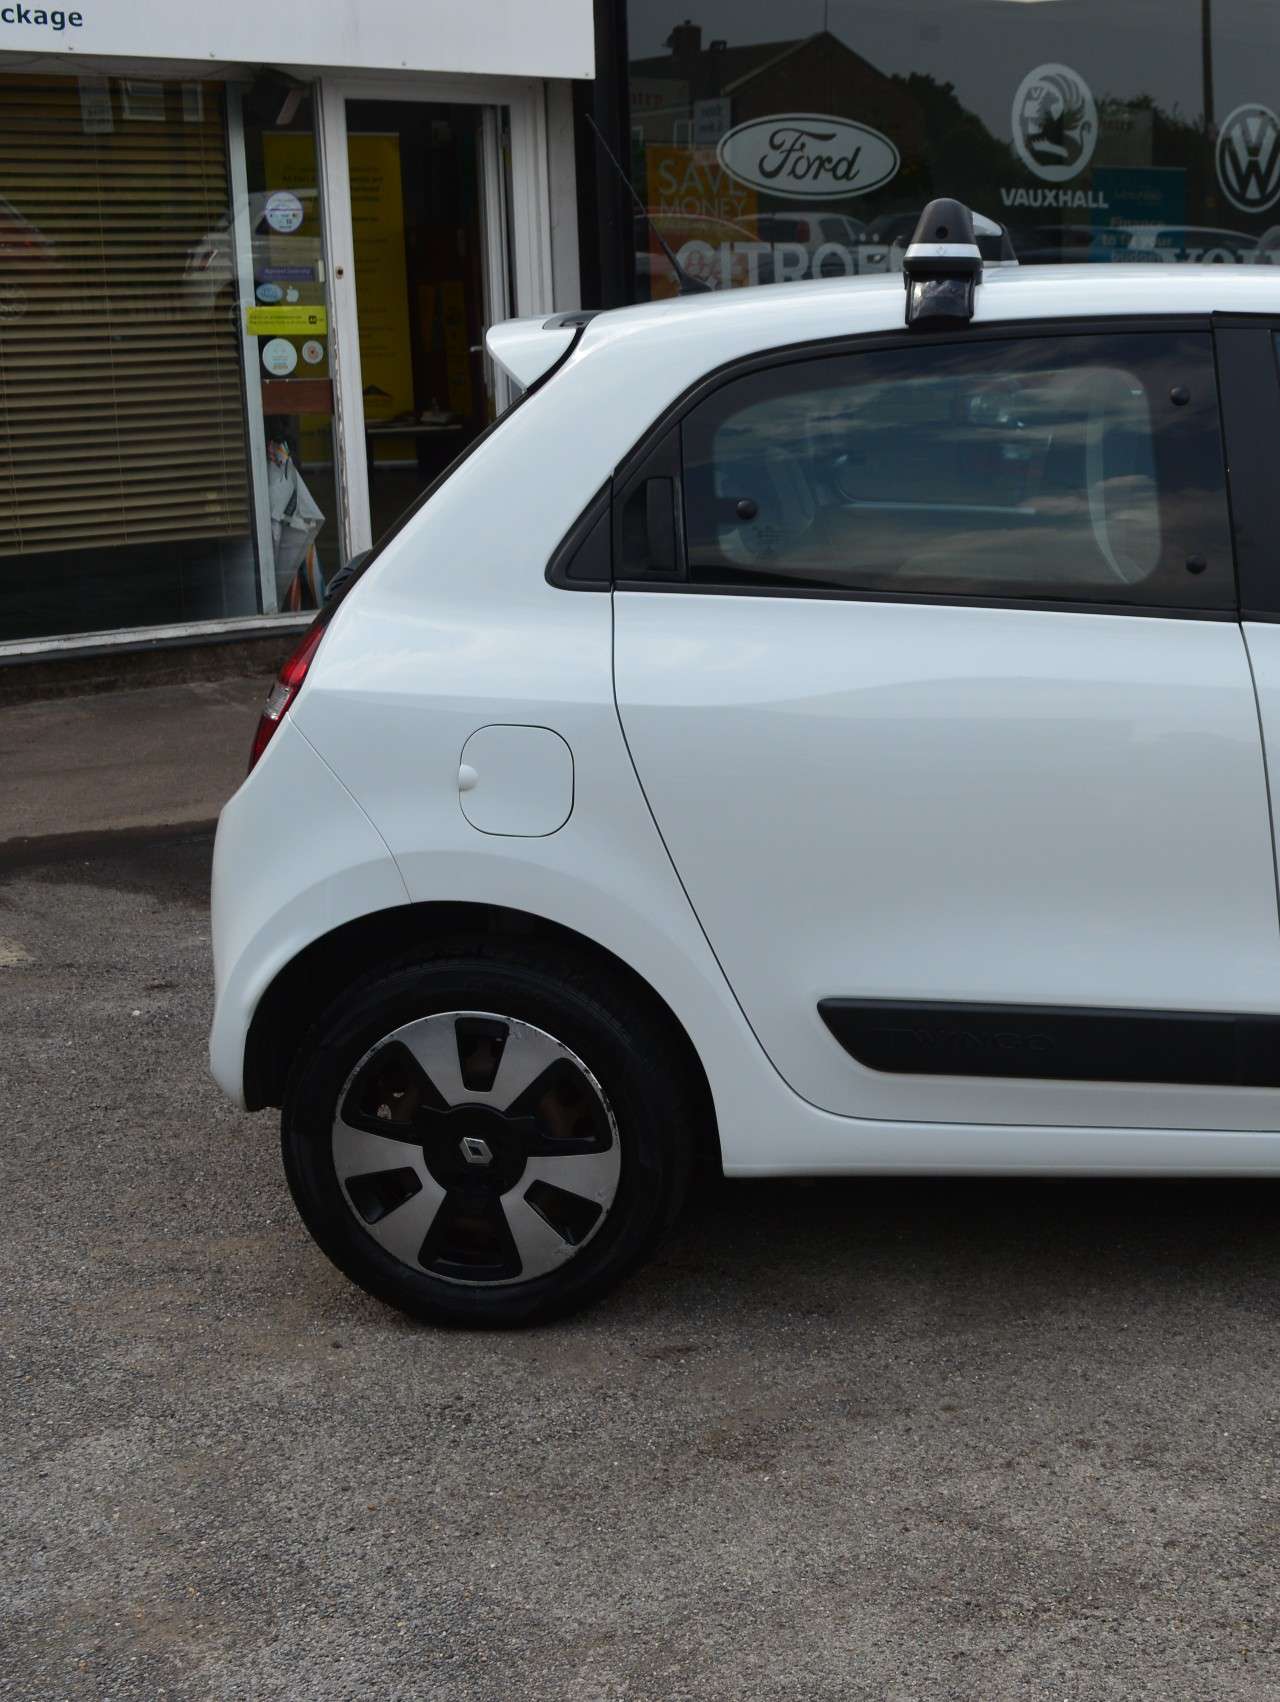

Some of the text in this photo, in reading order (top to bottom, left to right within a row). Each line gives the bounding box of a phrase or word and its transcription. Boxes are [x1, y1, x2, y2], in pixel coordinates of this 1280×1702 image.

[1, 3, 83, 31] ckage
[758, 127, 862, 182] Ford
[659, 195, 748, 221] MONEY
[1001, 187, 1109, 209] VAUXHALL
